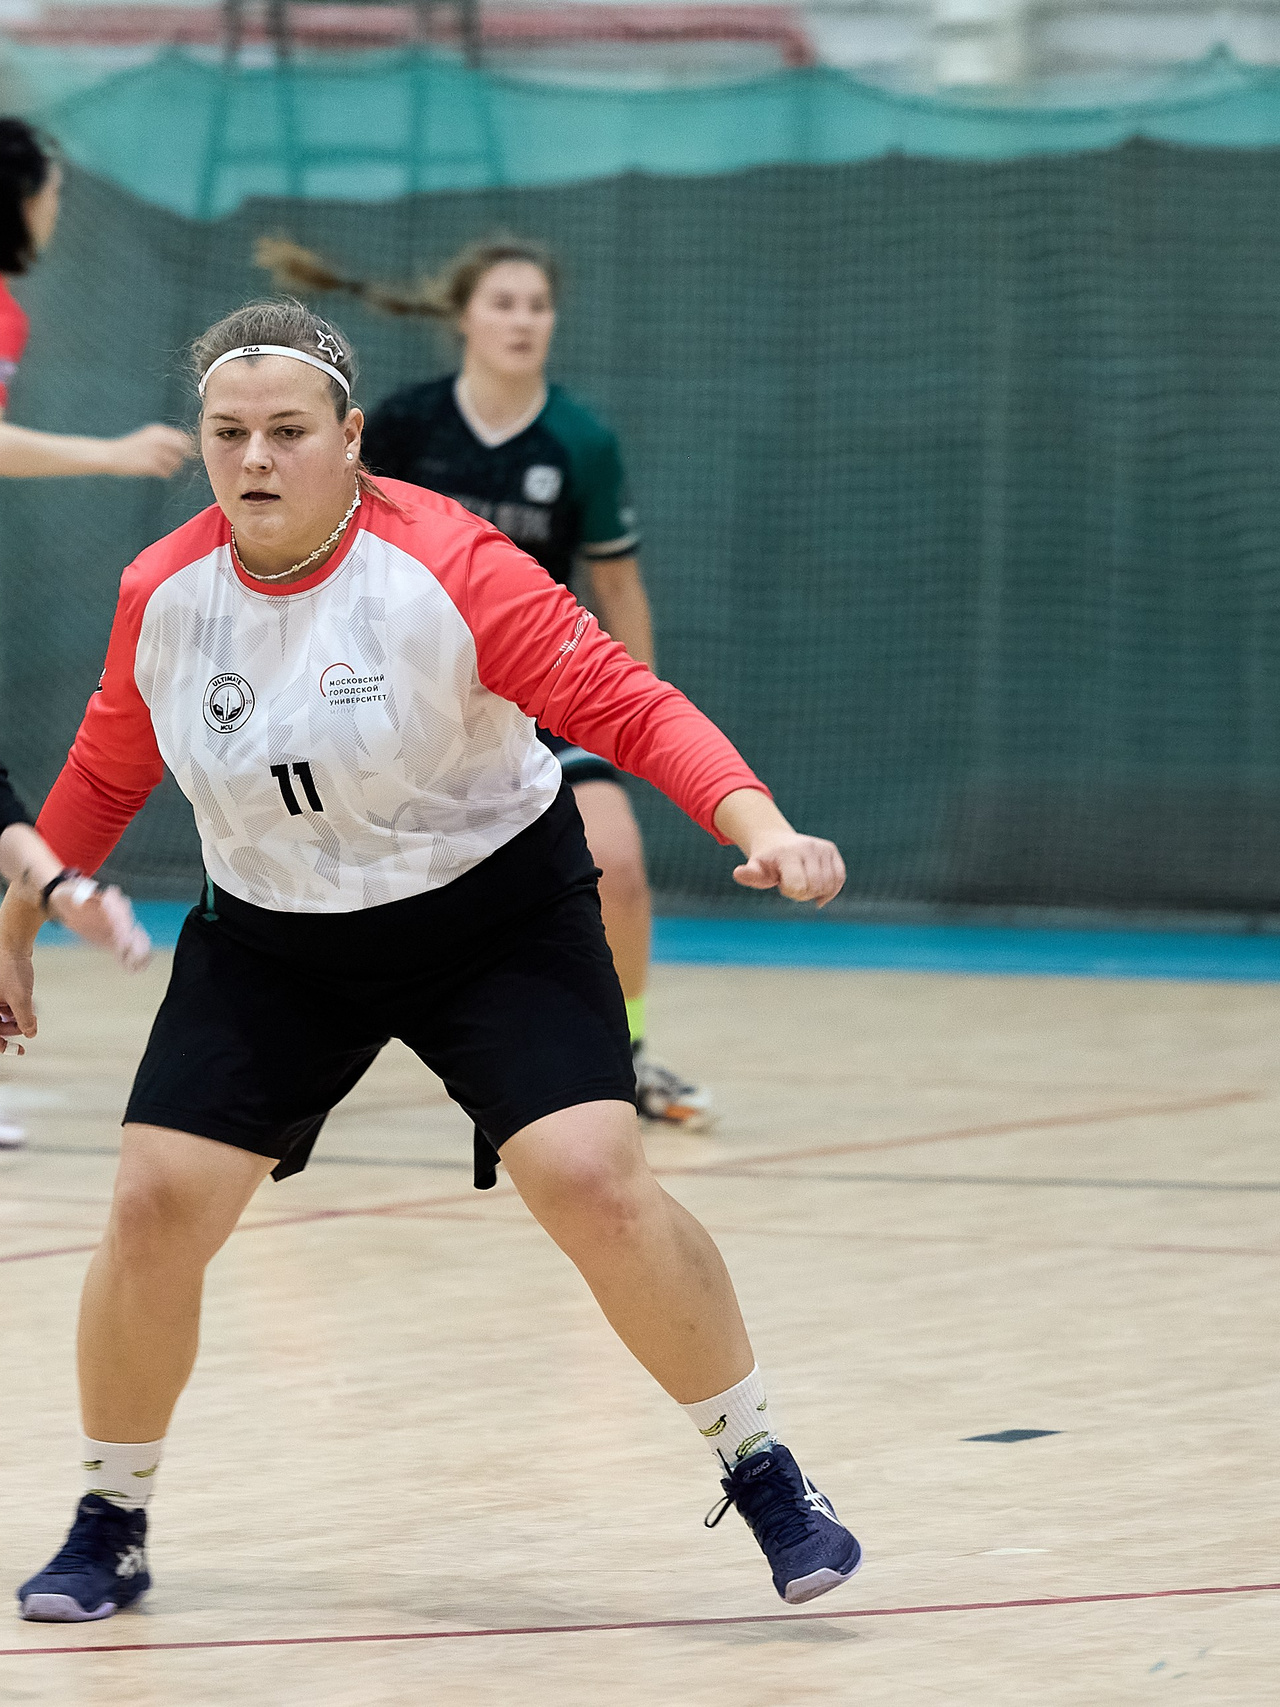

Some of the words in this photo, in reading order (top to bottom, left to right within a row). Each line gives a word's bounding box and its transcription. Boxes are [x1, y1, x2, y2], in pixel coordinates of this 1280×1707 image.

[212, 675, 242, 687] ULTIMATE
[329, 674, 385, 687] МОСКОВСКИЙ
[329, 685, 379, 696] ГОРОДСКОЙ
[329, 694, 387, 706] УНИВЕРСИТЕТ
[270, 761, 324, 816] 11
